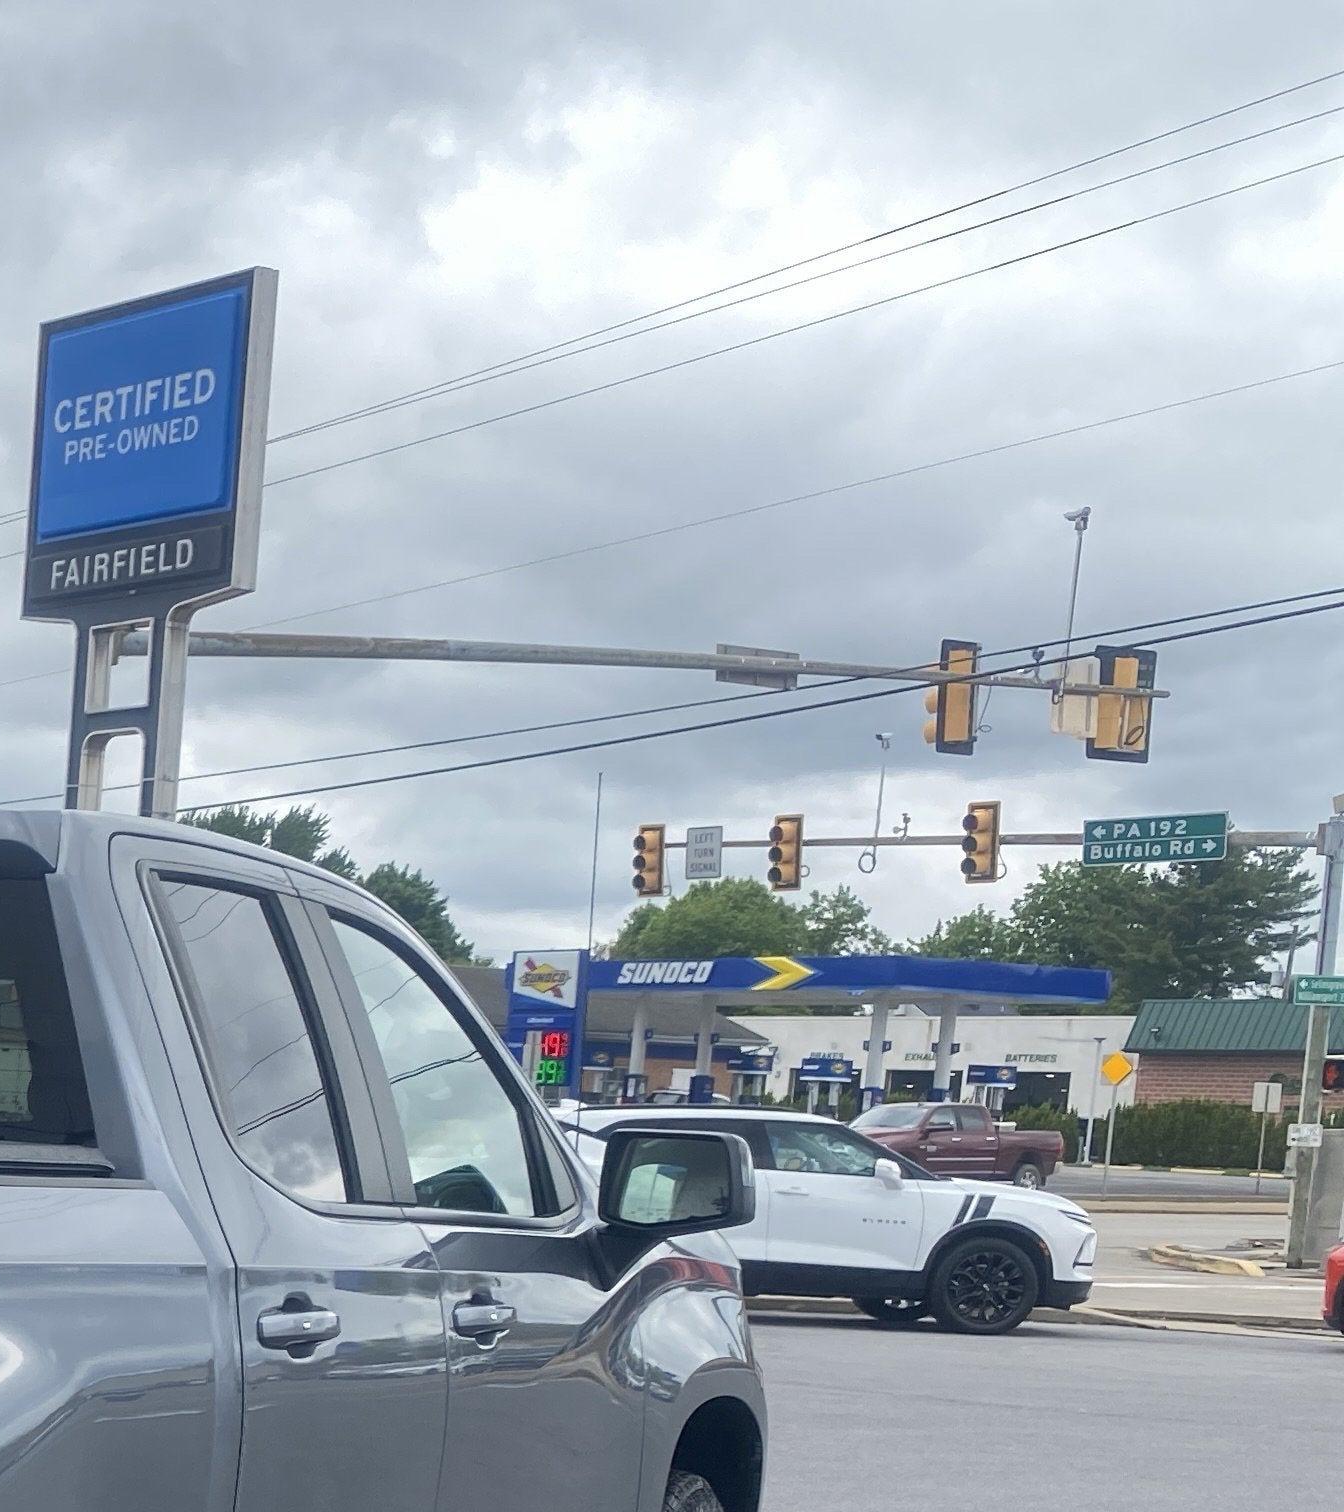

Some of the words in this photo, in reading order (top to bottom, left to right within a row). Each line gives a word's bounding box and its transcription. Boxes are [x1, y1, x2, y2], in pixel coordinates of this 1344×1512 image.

[53, 368, 217, 434] CERTIFIED
[64, 415, 199, 465] PRE-OWNED
[50, 538, 194, 591] FAIRFIELD
[694, 831, 714, 844] LEFT
[1113, 823, 1141, 839] PA
[1149, 819, 1187, 837] 192
[694, 847, 714, 859] TURN
[1090, 842, 1161, 860] Buffalo
[1169, 839, 1195, 855] Rd
[689, 862, 718, 873] SIGNAL
[521, 972, 567, 987] SUNOCO
[616, 960, 714, 984] SUNOCO
[1004, 1053, 1058, 1063] BATTERIES
